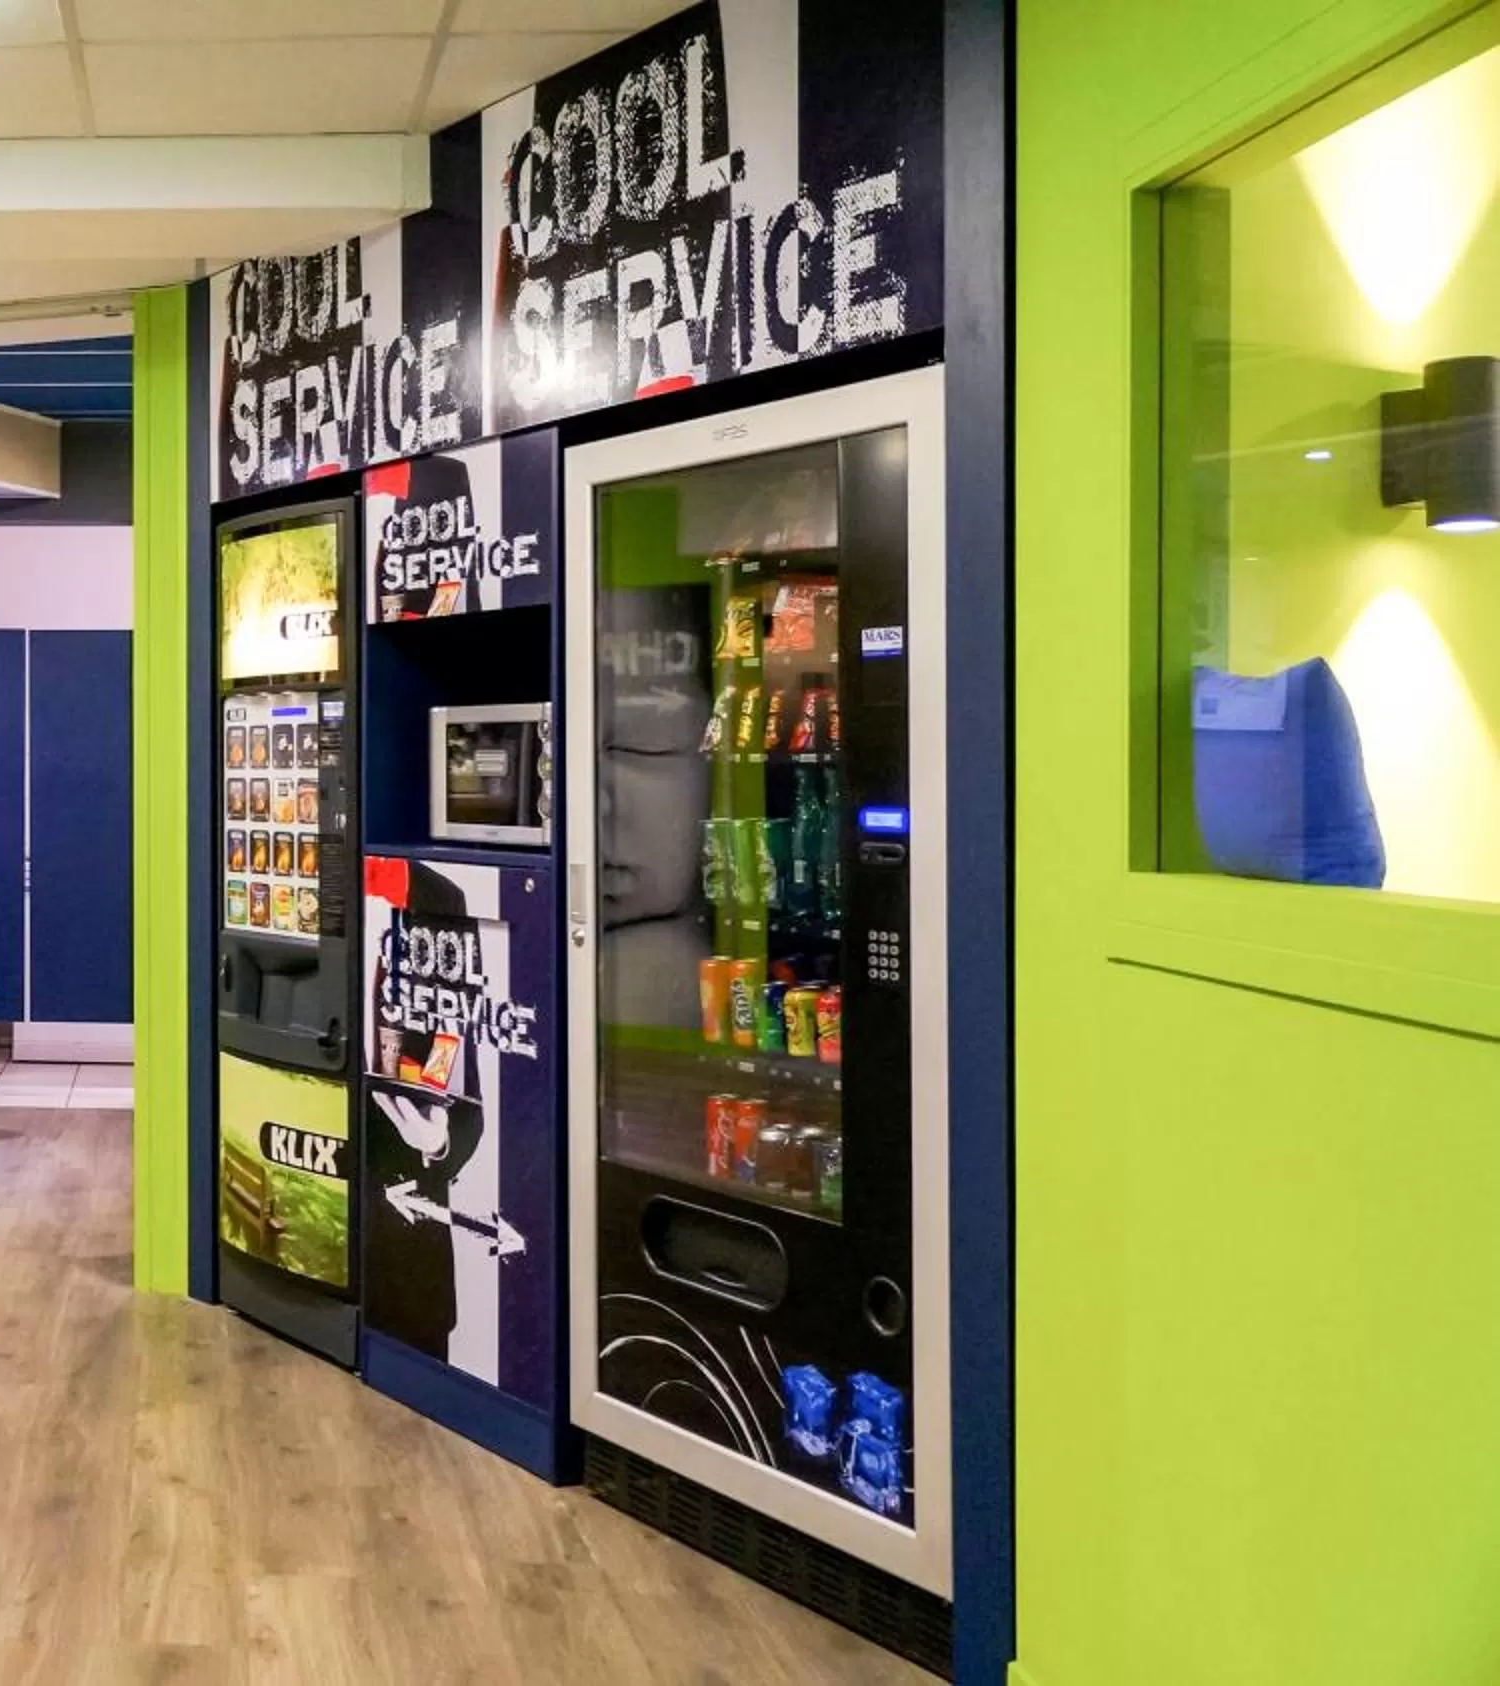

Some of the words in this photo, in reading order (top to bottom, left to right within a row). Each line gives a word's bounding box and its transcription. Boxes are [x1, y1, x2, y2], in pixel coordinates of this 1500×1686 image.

[505, 33, 746, 265] COOL
[227, 238, 372, 365] COOL
[510, 165, 906, 411] SERVICE
[229, 318, 461, 486] SERVICE
[382, 496, 481, 550] COOL
[382, 533, 540, 591] SERVICE
[381, 923, 489, 986] COOL
[380, 976, 538, 1061] SERVICE
[270, 1126, 338, 1176] KLIX
